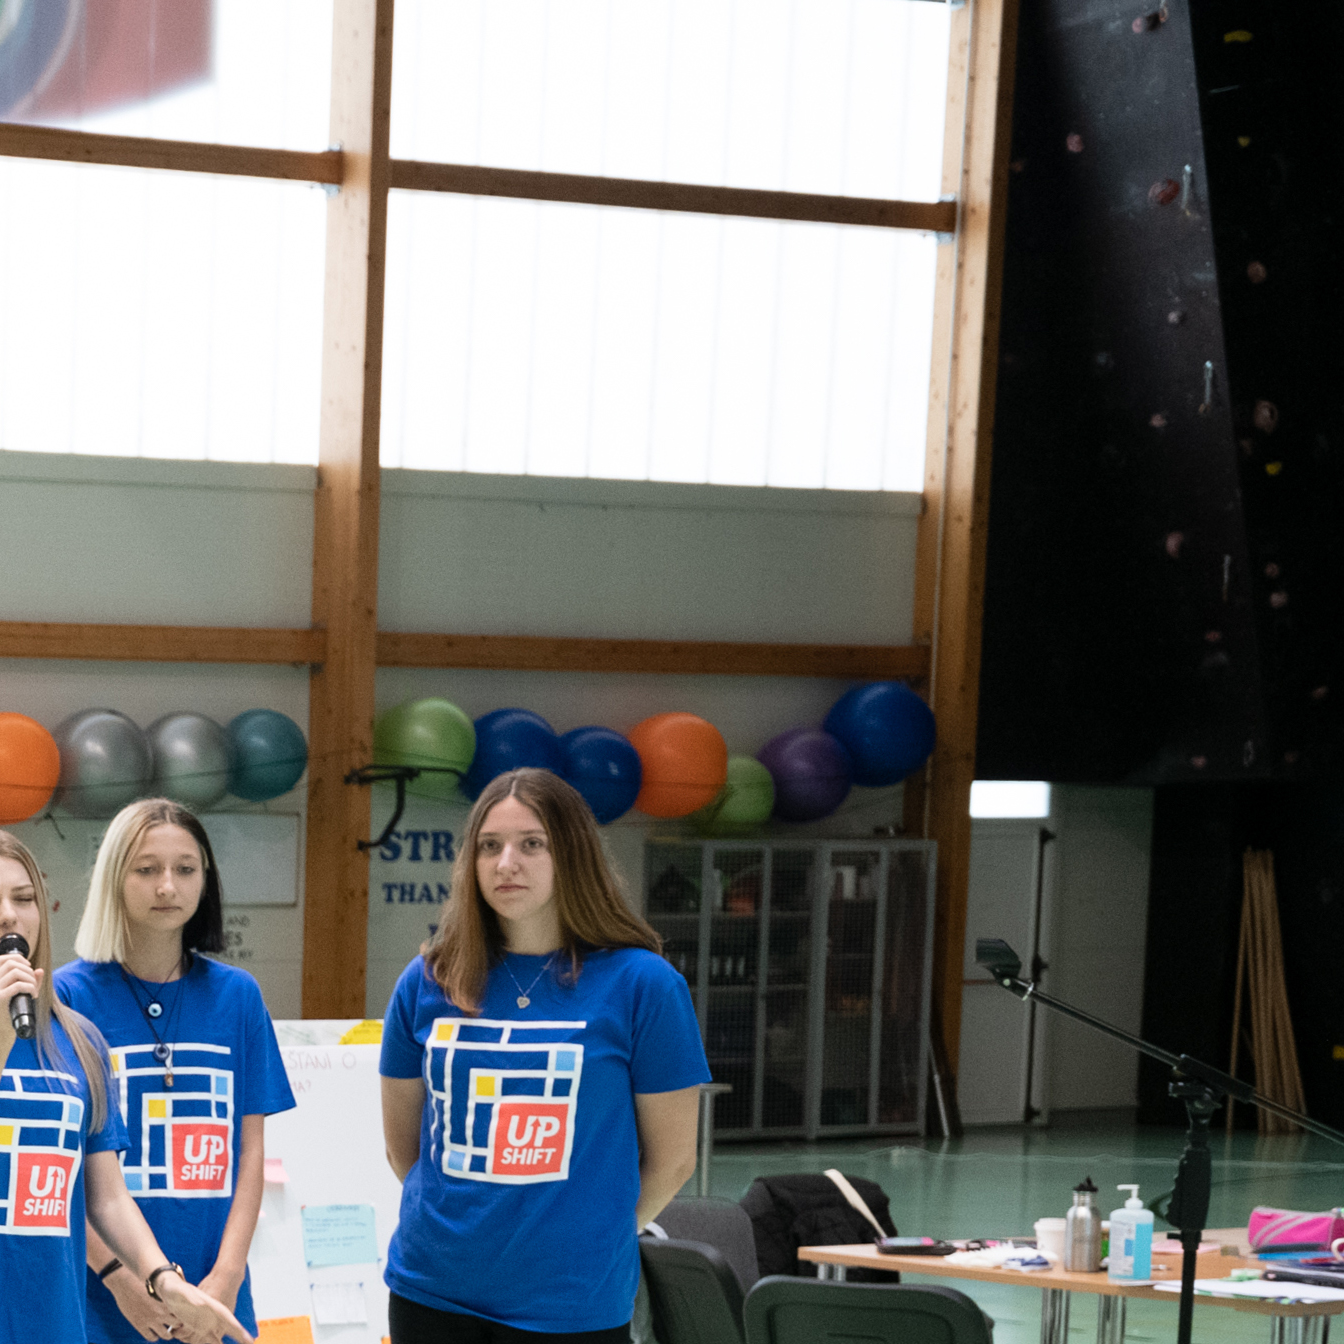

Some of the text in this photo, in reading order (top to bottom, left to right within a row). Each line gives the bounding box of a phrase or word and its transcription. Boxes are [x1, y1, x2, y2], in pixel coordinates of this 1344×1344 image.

[507, 1115, 560, 1147] UP
[184, 1135, 225, 1164] UP
[501, 1147, 556, 1165] SHIFT
[29, 1165, 65, 1198] UP
[181, 1165, 225, 1181] SHIFT
